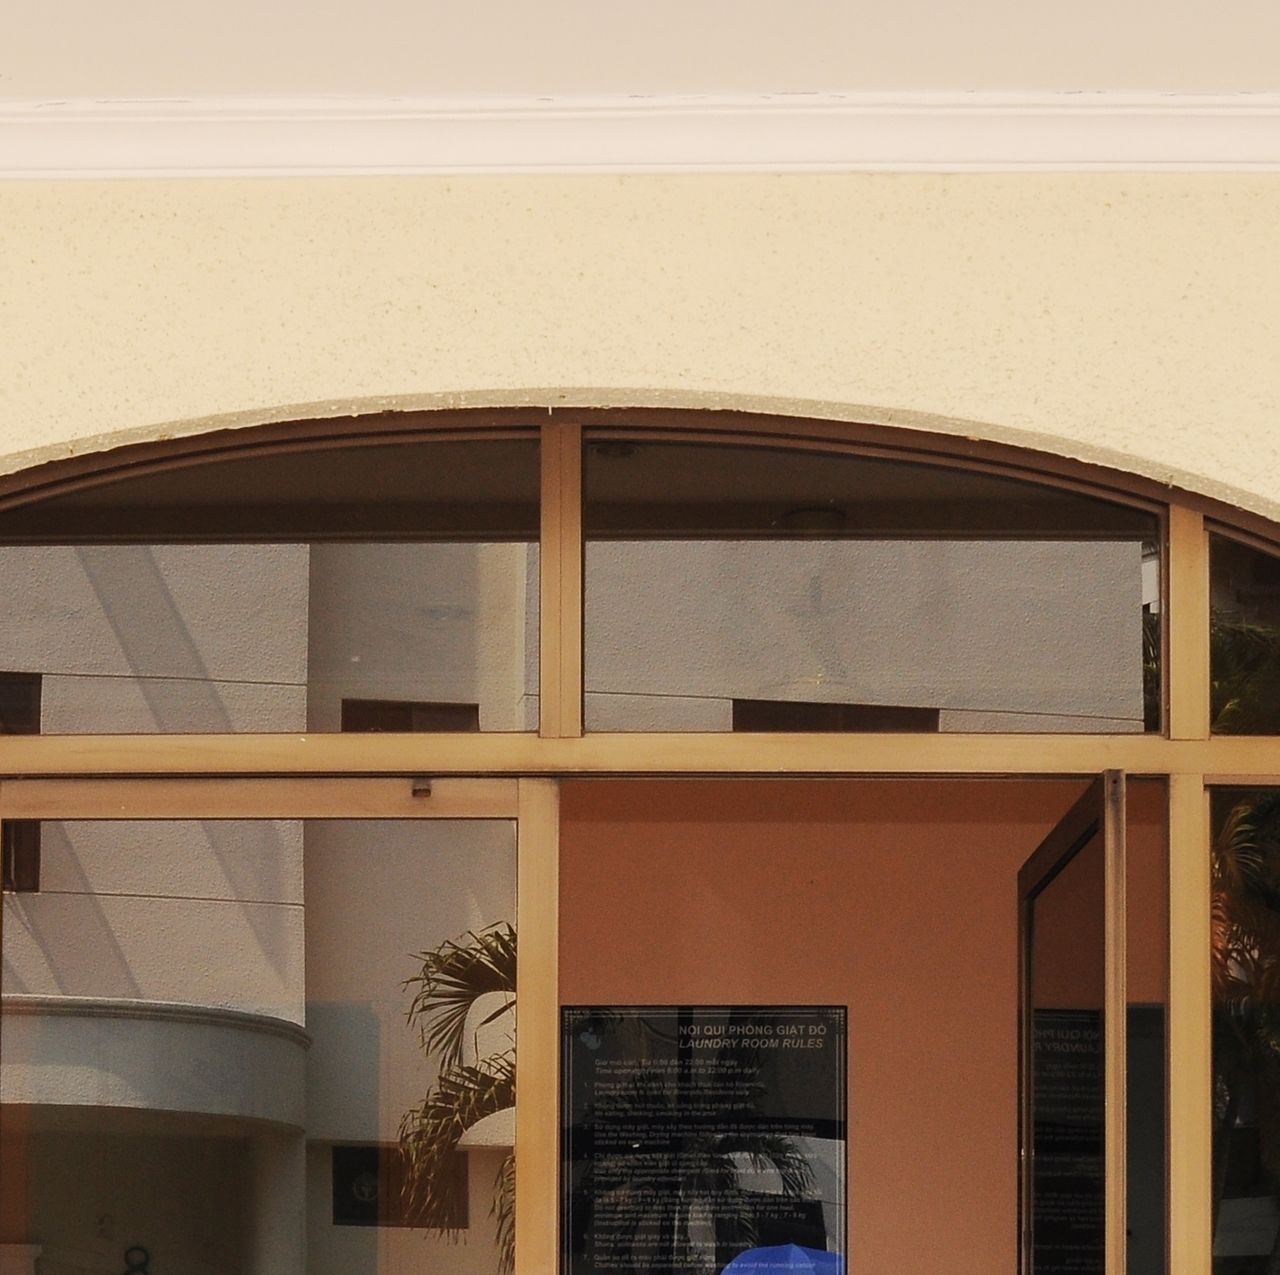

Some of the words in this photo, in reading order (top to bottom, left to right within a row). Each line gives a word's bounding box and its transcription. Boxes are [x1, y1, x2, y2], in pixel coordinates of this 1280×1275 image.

[679, 1038, 739, 1049] LAUNDRY
[741, 1038, 779, 1049] ROOM
[783, 1038, 823, 1049] RULES
